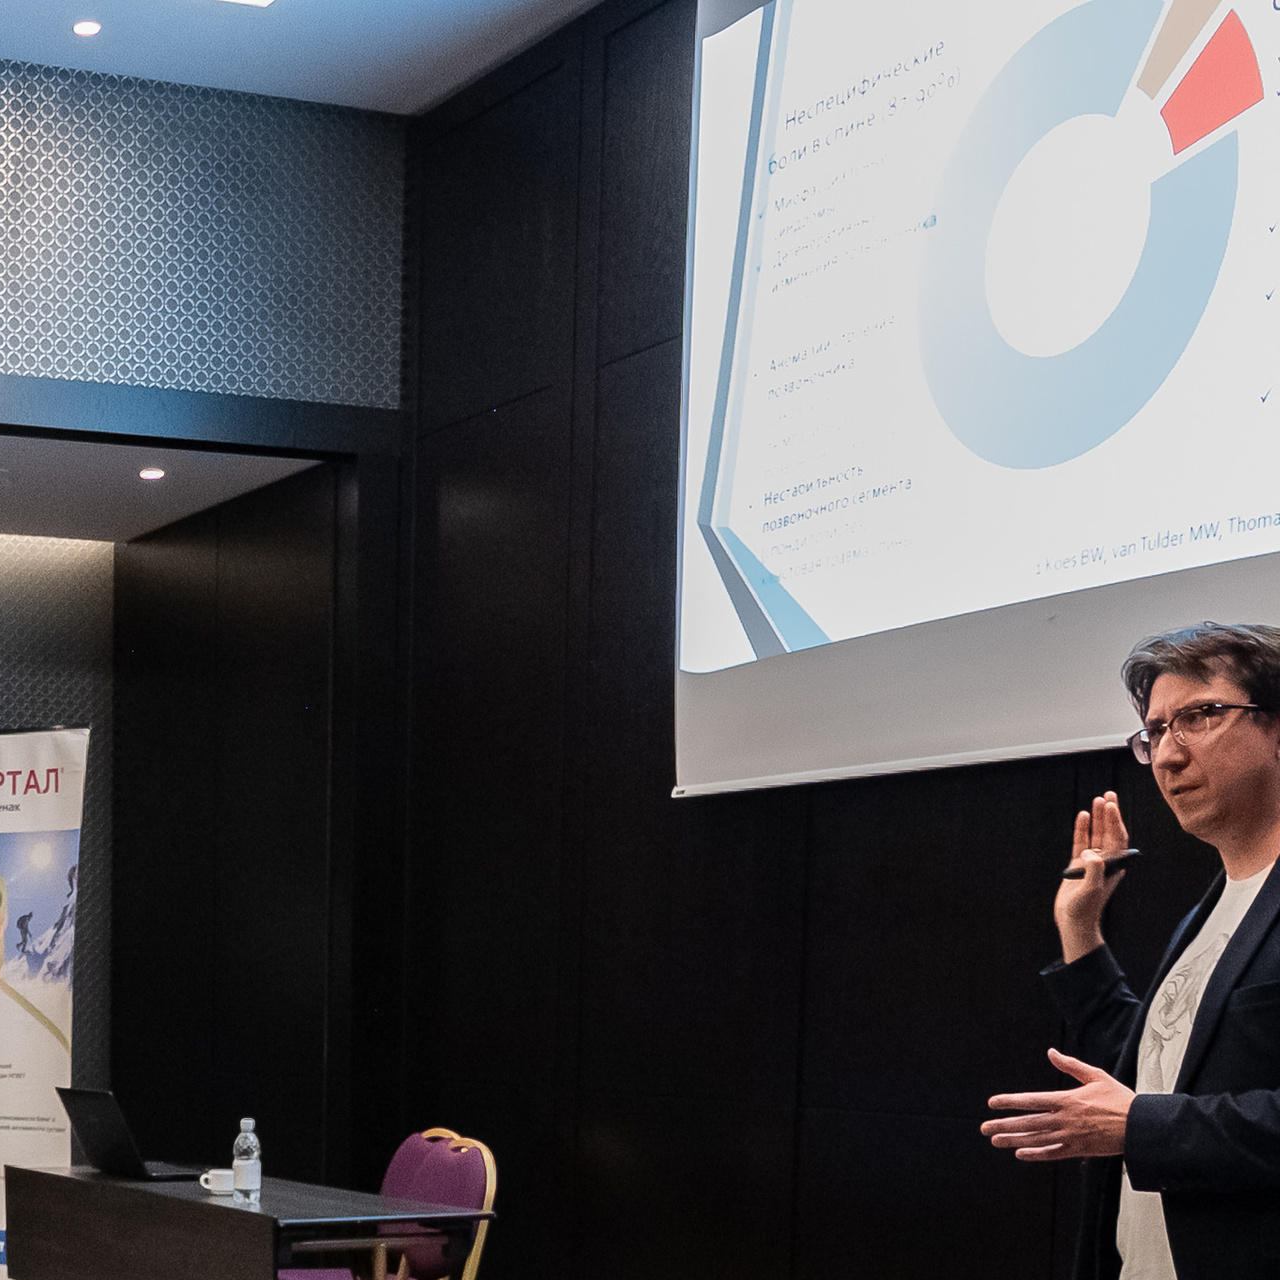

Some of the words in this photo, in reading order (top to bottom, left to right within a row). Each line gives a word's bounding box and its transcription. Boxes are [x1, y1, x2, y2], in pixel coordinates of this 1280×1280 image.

[785, 41, 945, 130] Неспецифические
[769, 145, 807, 175] боли
[761, 496, 850, 533] позвоночного
[1045, 554, 1077, 572] Koes
[1112, 542, 1136, 559] van
[1140, 530, 1184, 553] Tulder
[1189, 521, 1223, 542] MW,
